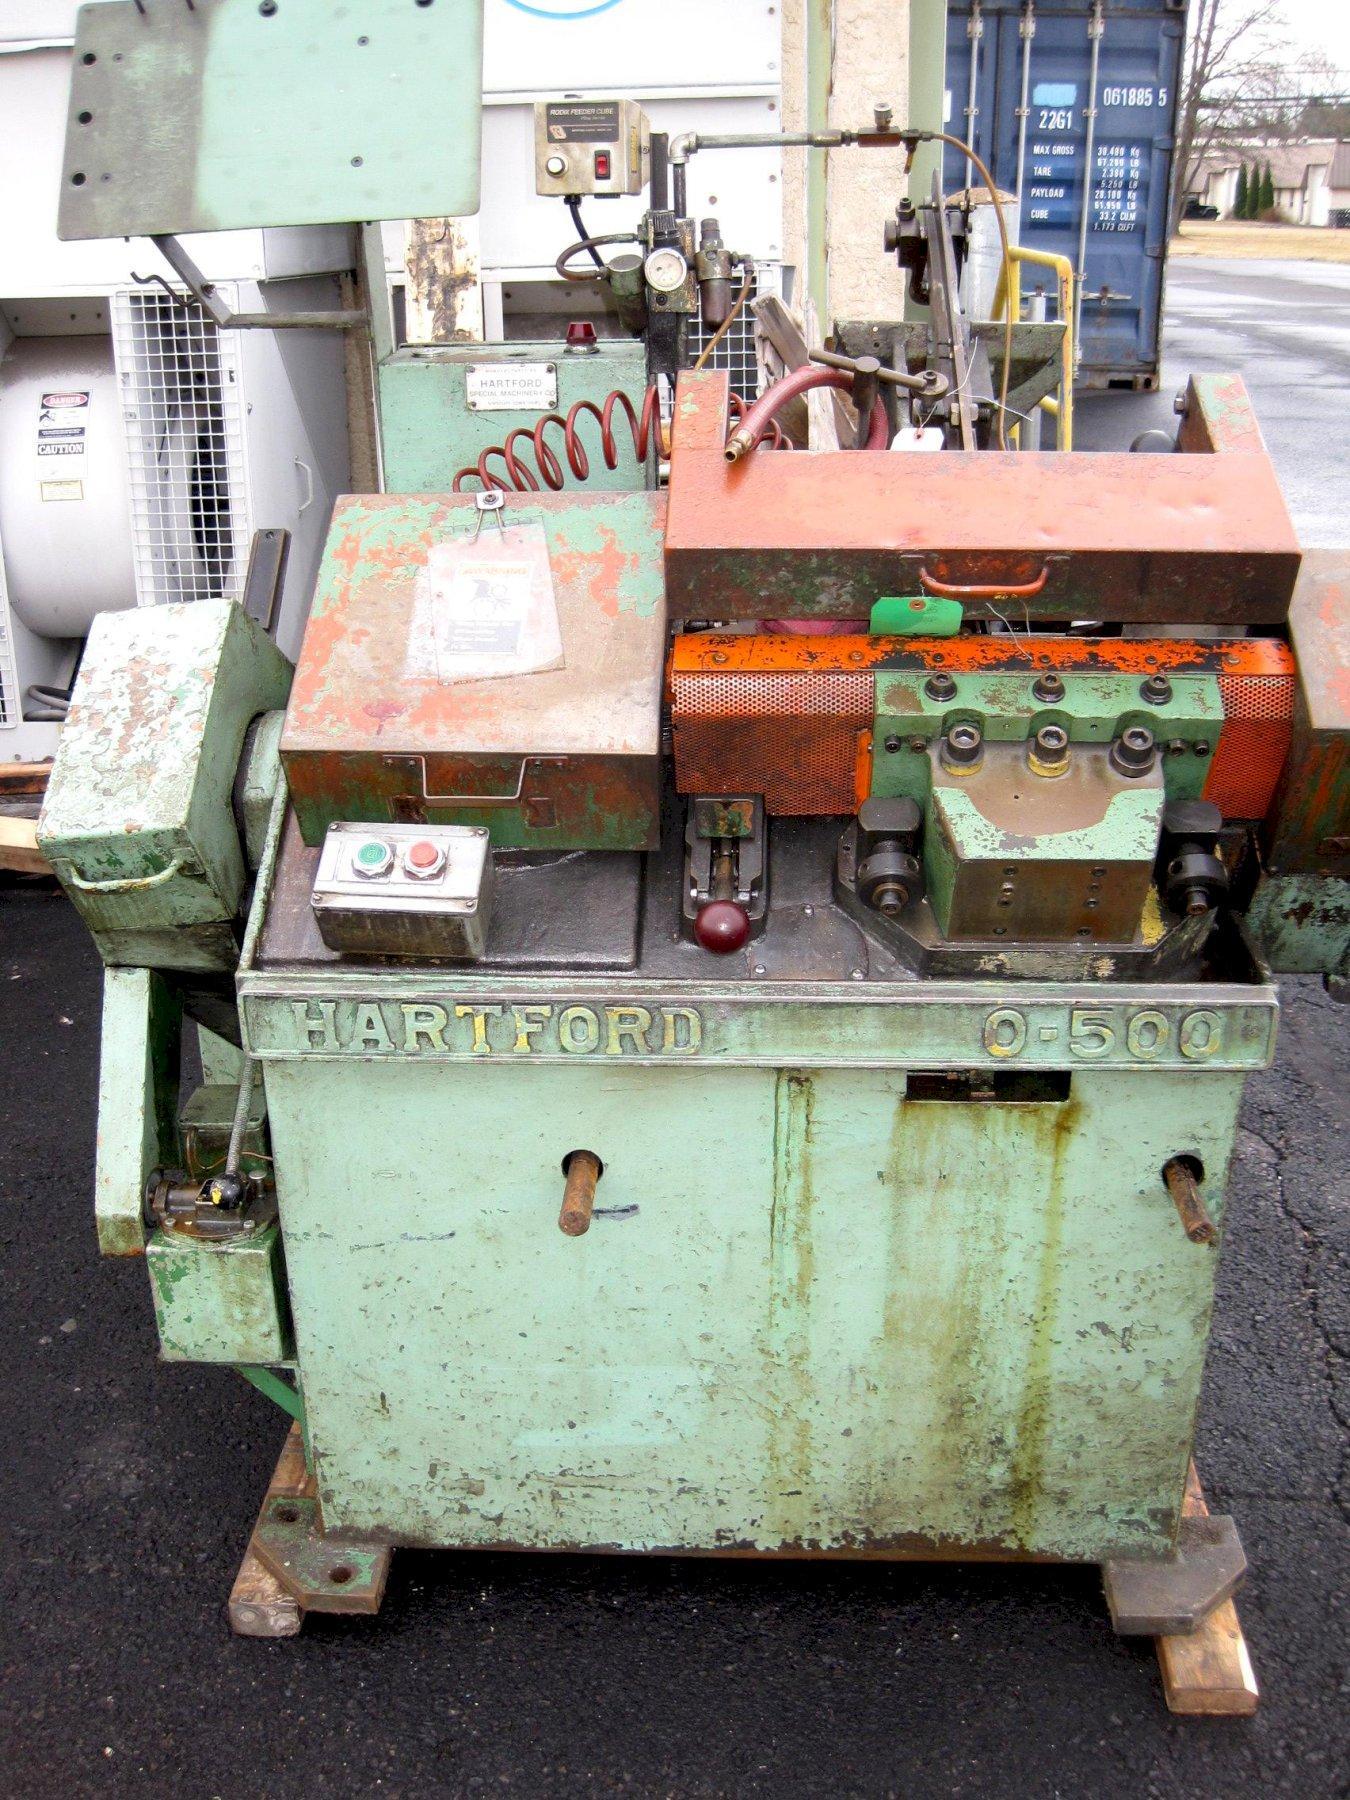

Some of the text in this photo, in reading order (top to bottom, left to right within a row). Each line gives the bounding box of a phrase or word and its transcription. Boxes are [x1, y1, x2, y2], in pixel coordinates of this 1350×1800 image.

[1103, 87, 1167, 107] 061885 5
[596, 107, 614, 115] CUBE
[1039, 109, 1072, 130] 22G1
[1033, 145, 1050, 155] MAX
[1051, 145, 1075, 156] GROSS
[1130, 158, 1140, 168] LB
[1033, 166, 1052, 177] TARE
[1128, 180, 1138, 190] LB
[1031, 188, 1064, 198] PAYLOAD
[1126, 201, 1136, 211] LB
[1030, 209, 1048, 219] CUBE
[1099, 211, 1116, 221] 33.2
[480, 379, 542, 389] HARTFORD
[469, 390, 498, 398] SPECIAL
[500, 390, 543, 398] MACHINERY
[38, 443, 84, 455] CAUTION
[292, 1001, 702, 1056] HARTFORD
